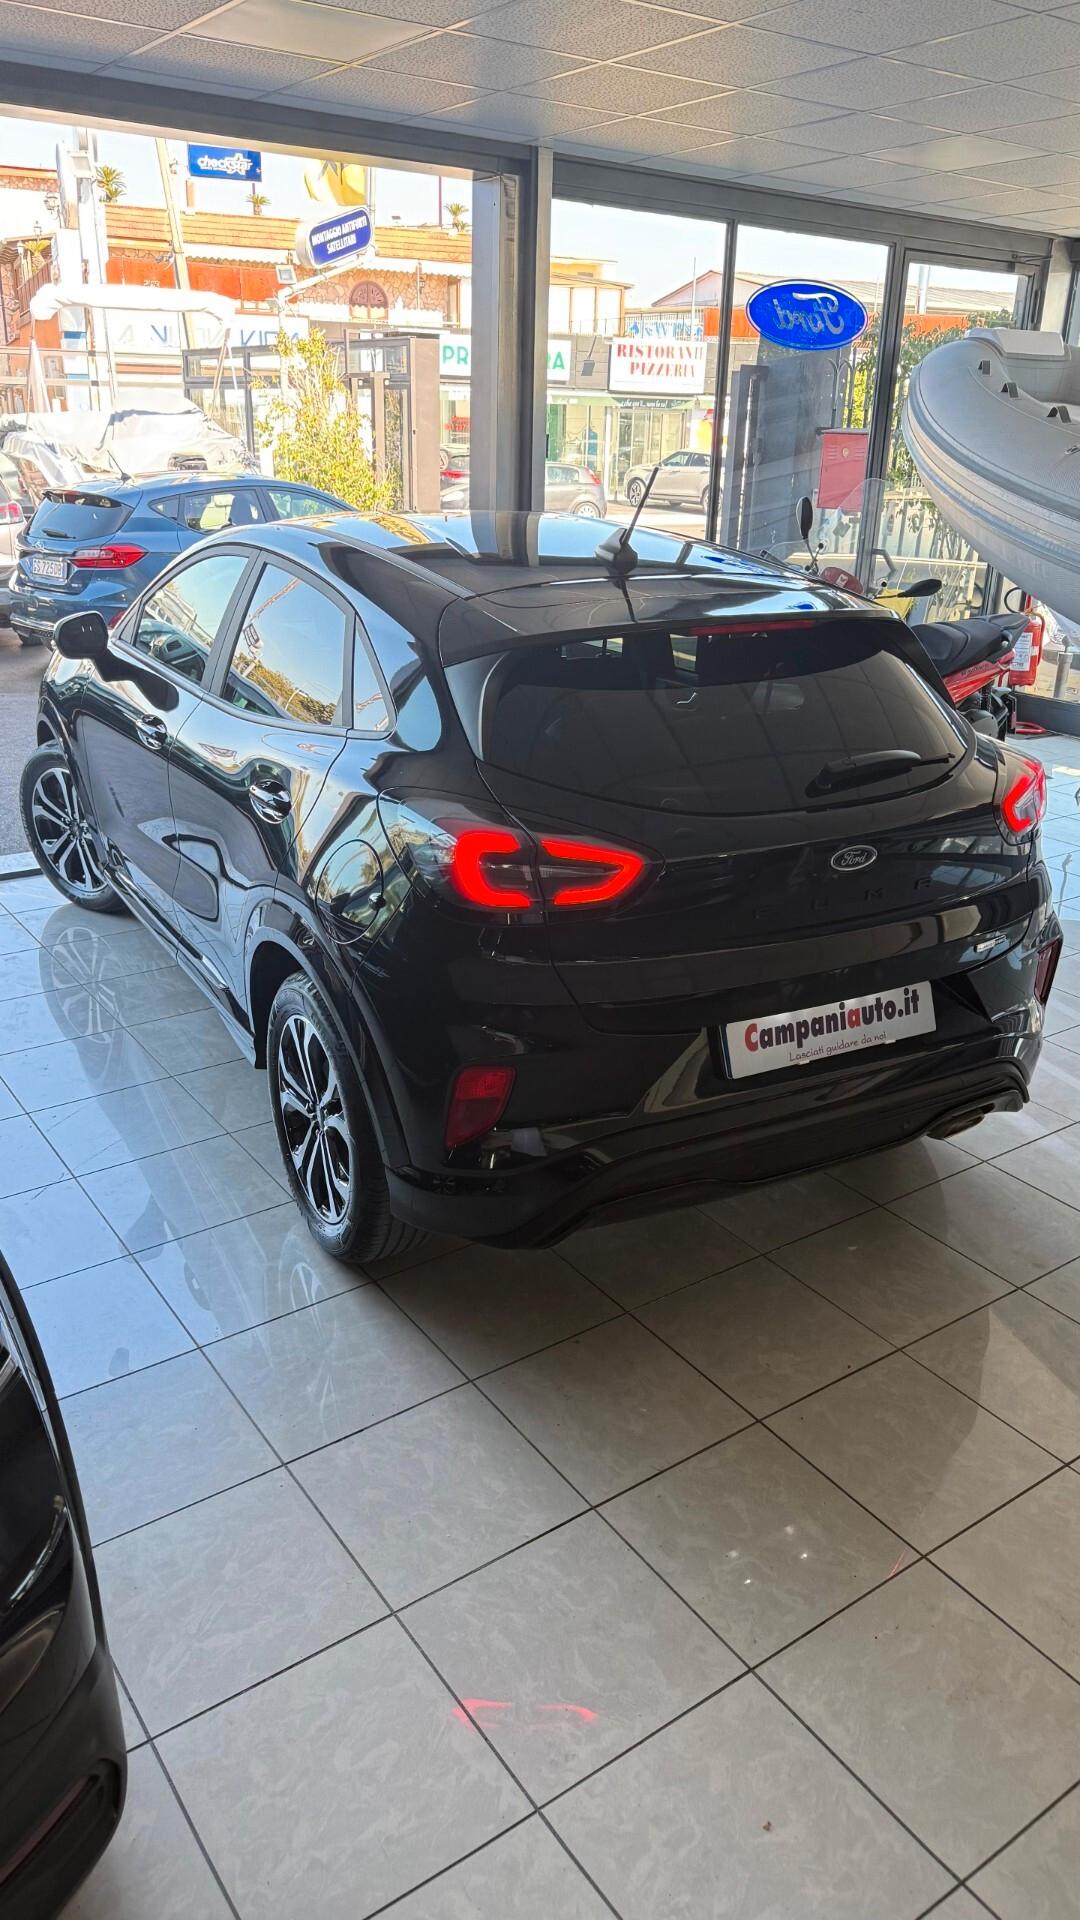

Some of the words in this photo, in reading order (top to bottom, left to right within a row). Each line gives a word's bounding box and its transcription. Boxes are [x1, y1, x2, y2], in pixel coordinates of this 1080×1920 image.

[311, 225, 342, 247] MONTAGGIO
[841, 850, 868, 866] Ford
[744, 987, 920, 1052] Campaniauto.it
[789, 1047, 824, 1061] Lasciati
[826, 1040, 858, 1056] guidare
[861, 1034, 872, 1045] da
[874, 1031, 887, 1041] noi
